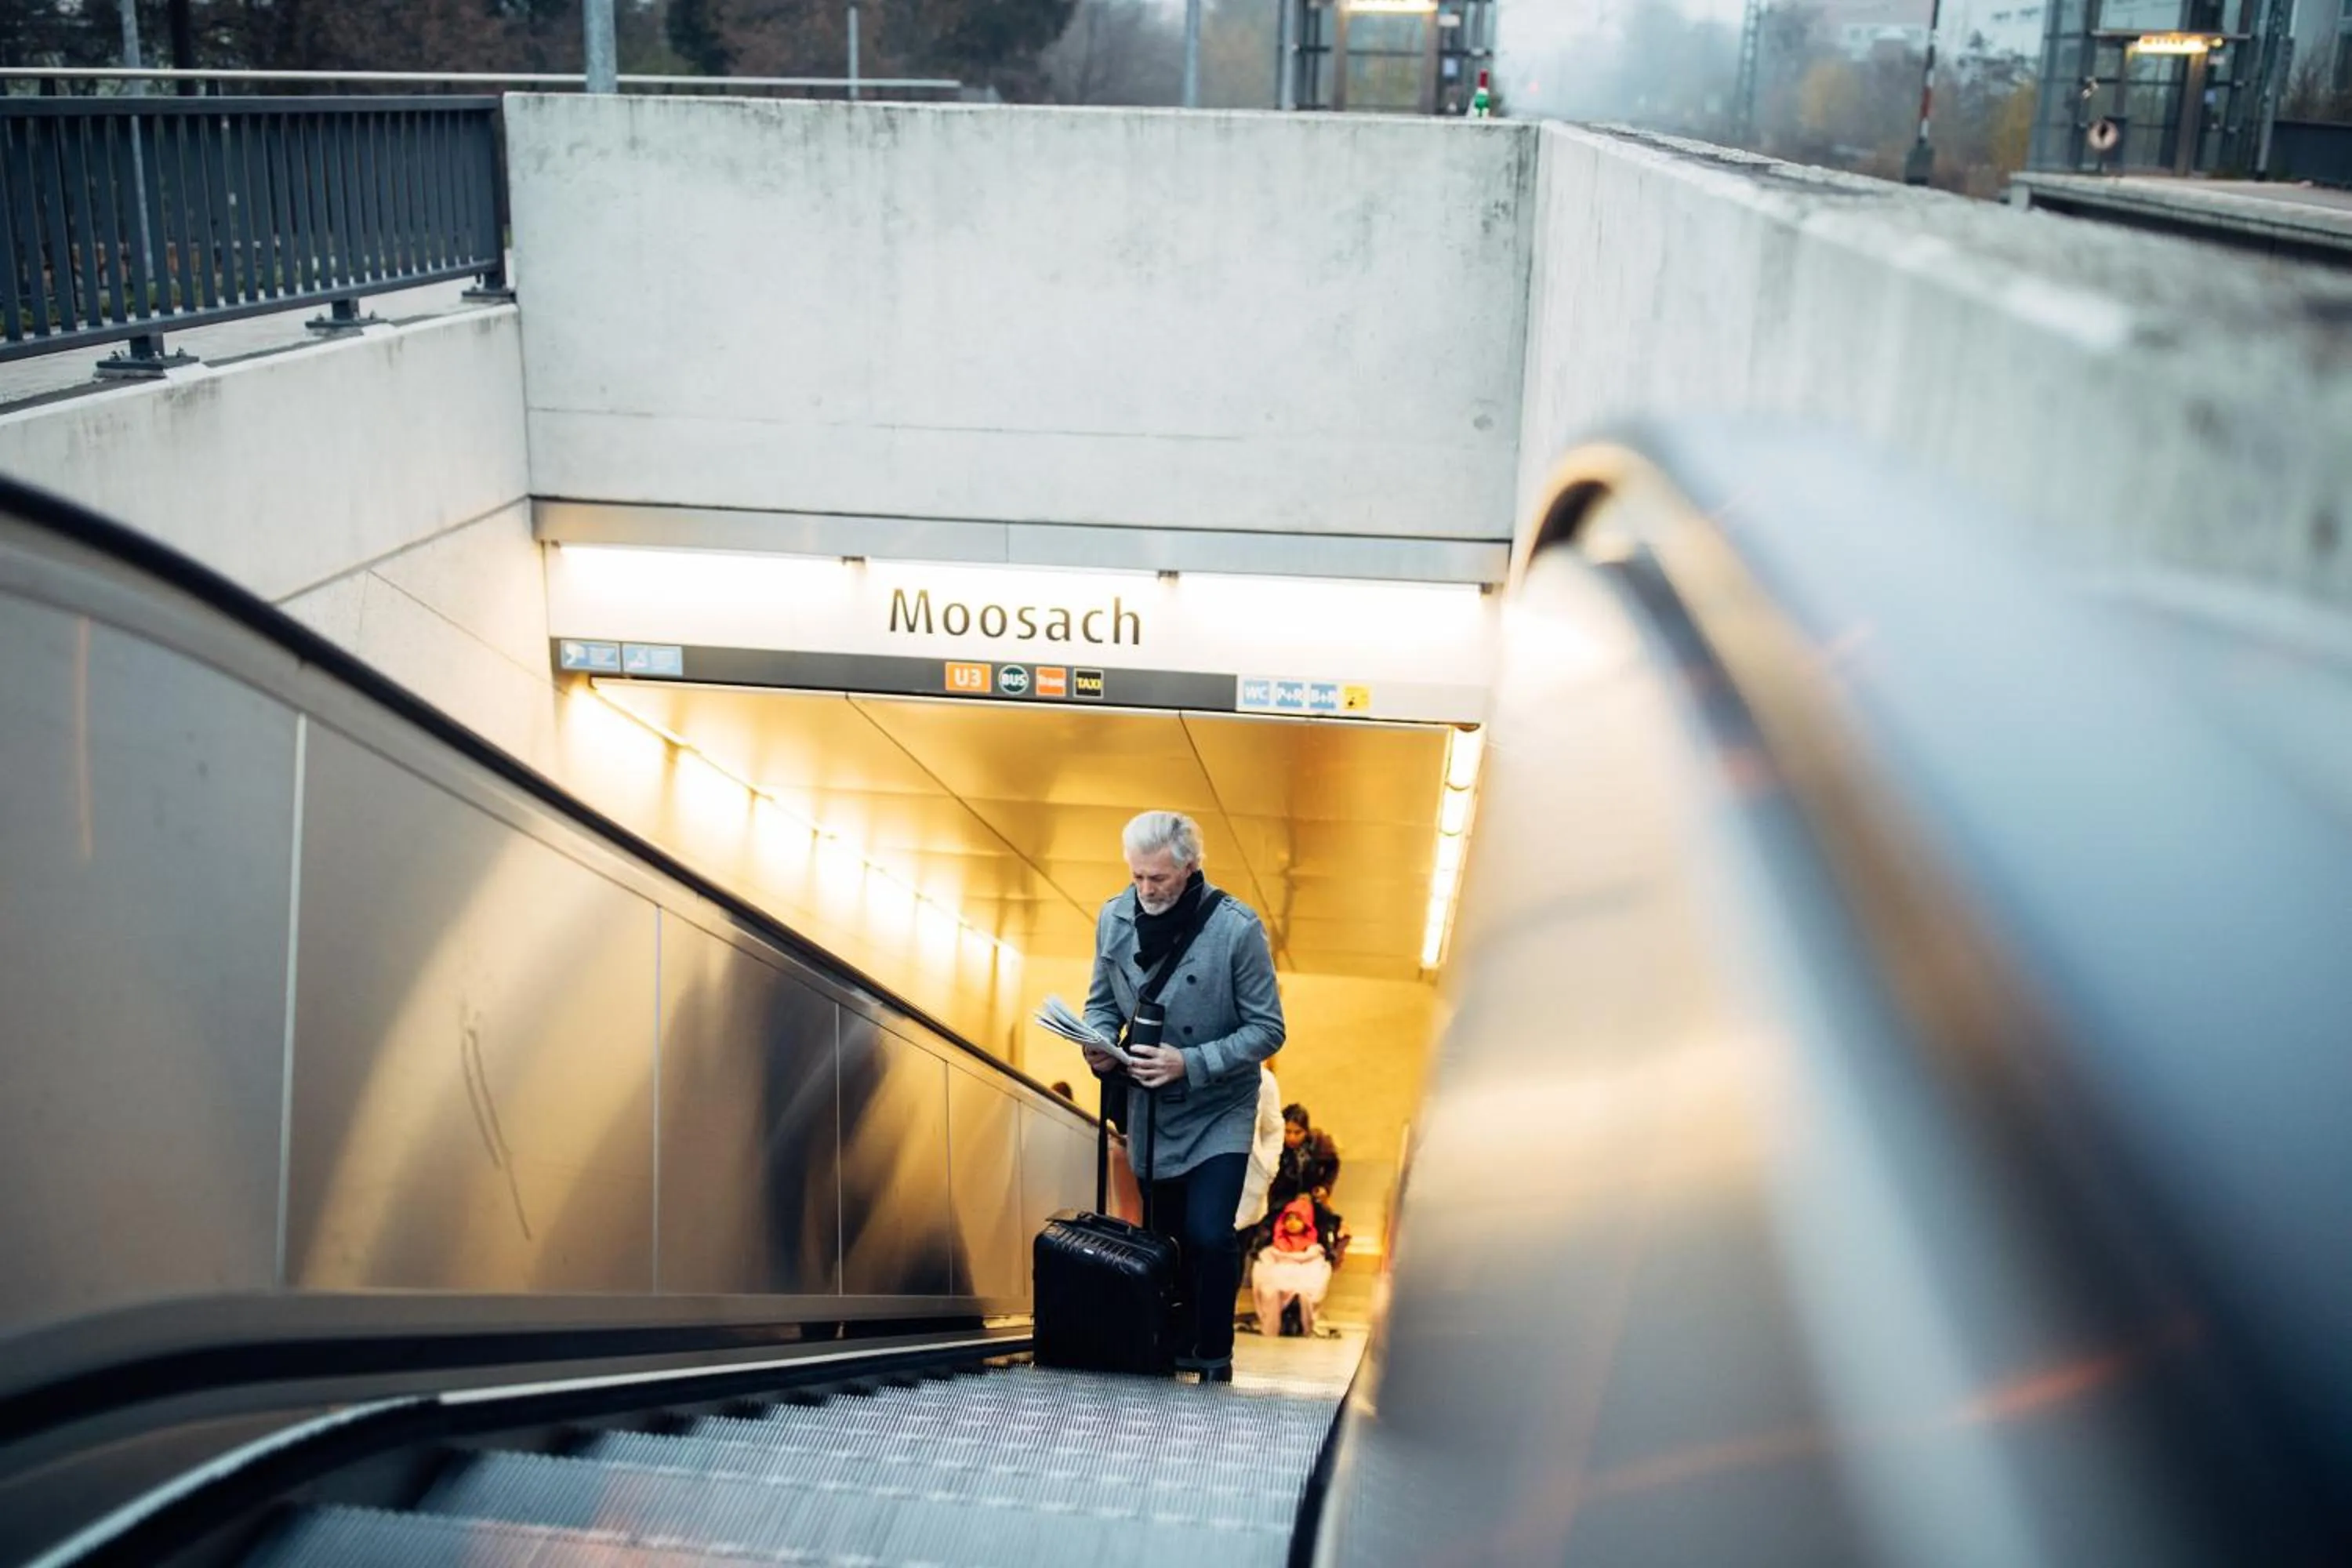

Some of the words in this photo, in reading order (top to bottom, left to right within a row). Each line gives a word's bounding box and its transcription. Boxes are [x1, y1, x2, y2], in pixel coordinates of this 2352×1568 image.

[889, 588, 1141, 644] Moosach
[954, 667, 982, 687] U3
[1001, 673, 1027, 687] BUS
[1076, 677, 1104, 689] TAXI
[1244, 686, 1268, 700] WC
